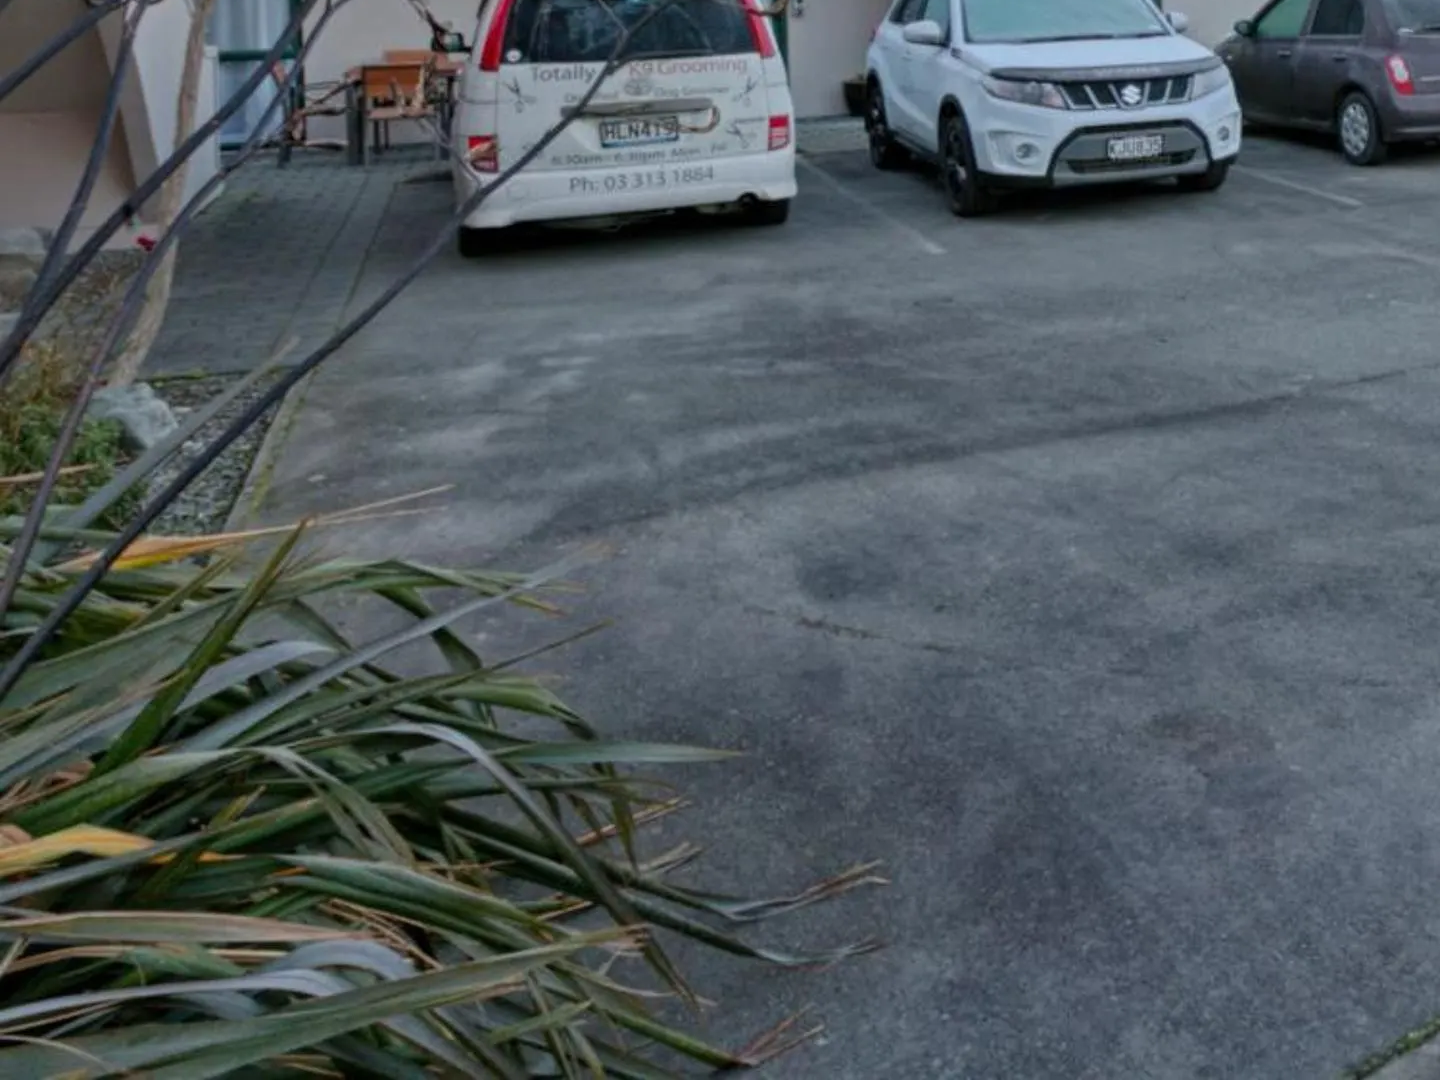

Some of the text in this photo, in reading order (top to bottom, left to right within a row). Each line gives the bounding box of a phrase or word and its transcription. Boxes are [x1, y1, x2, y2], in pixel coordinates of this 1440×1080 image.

[532, 64, 596, 84] Totally
[657, 58, 748, 79] Grooming
[569, 176, 599, 193] Ph:
[604, 173, 628, 191] 03
[632, 170, 666, 189] 313
